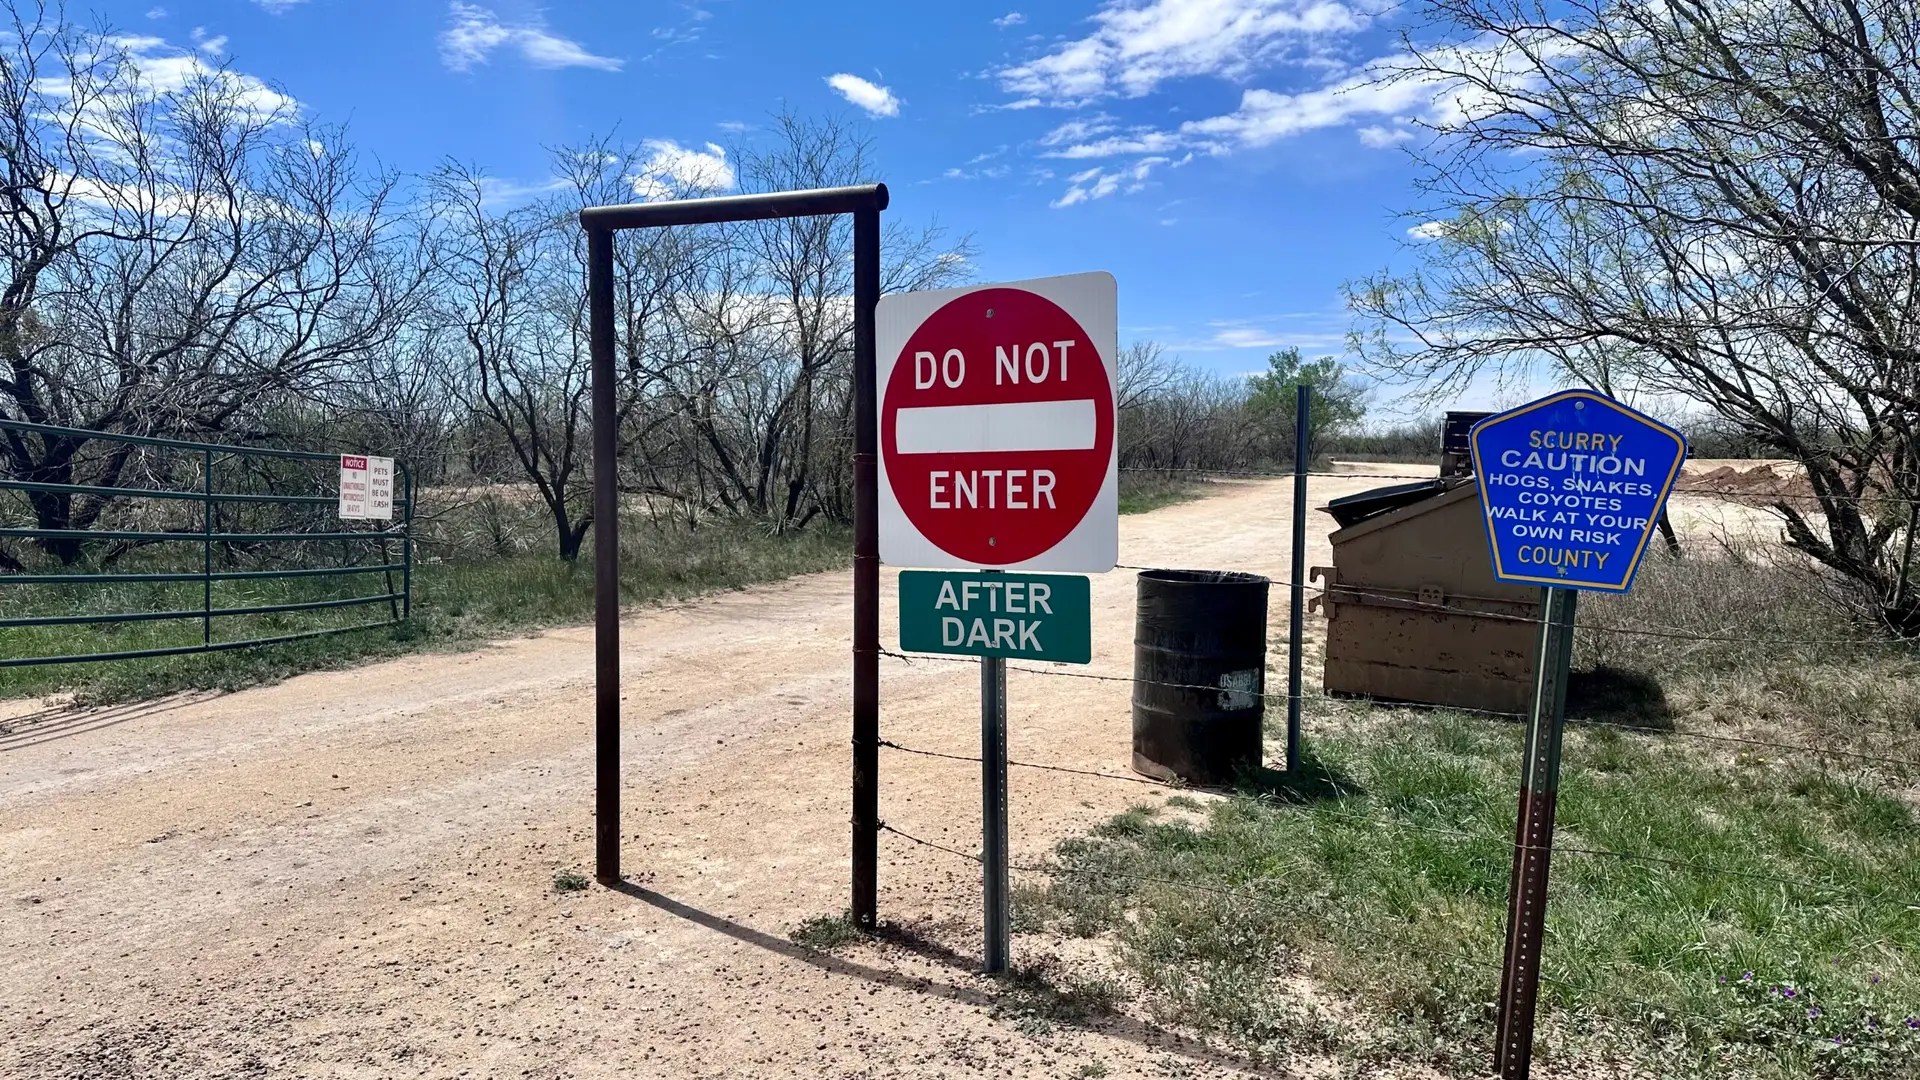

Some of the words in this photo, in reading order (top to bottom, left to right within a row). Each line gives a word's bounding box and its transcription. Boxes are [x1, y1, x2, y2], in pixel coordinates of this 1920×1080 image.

[915, 348, 965, 390] DO
[995, 340, 1076, 386] NOT
[1529, 430, 1623, 451] SCURRY
[345, 460, 364, 468] NOTICE
[374, 468, 388, 476] PETS
[1501, 450, 1646, 476] CAUTION
[372, 478, 389, 487] MUST
[930, 469, 1057, 510] ENTER
[1489, 473, 1554, 491] HOGS,
[1562, 478, 1658, 499] SNAKES,
[371, 500, 389, 508] LEASH
[1518, 492, 1622, 511] COYOTES
[1486, 506, 1547, 522] WALK
[1552, 511, 1580, 525] AT
[1586, 513, 1648, 530] YOUR
[1512, 525, 1563, 540] OWN
[1570, 529, 1622, 546] RISK
[1518, 545, 1610, 569] COUNTY
[934, 579, 1053, 614] AFTER
[942, 616, 1043, 652] DARK
